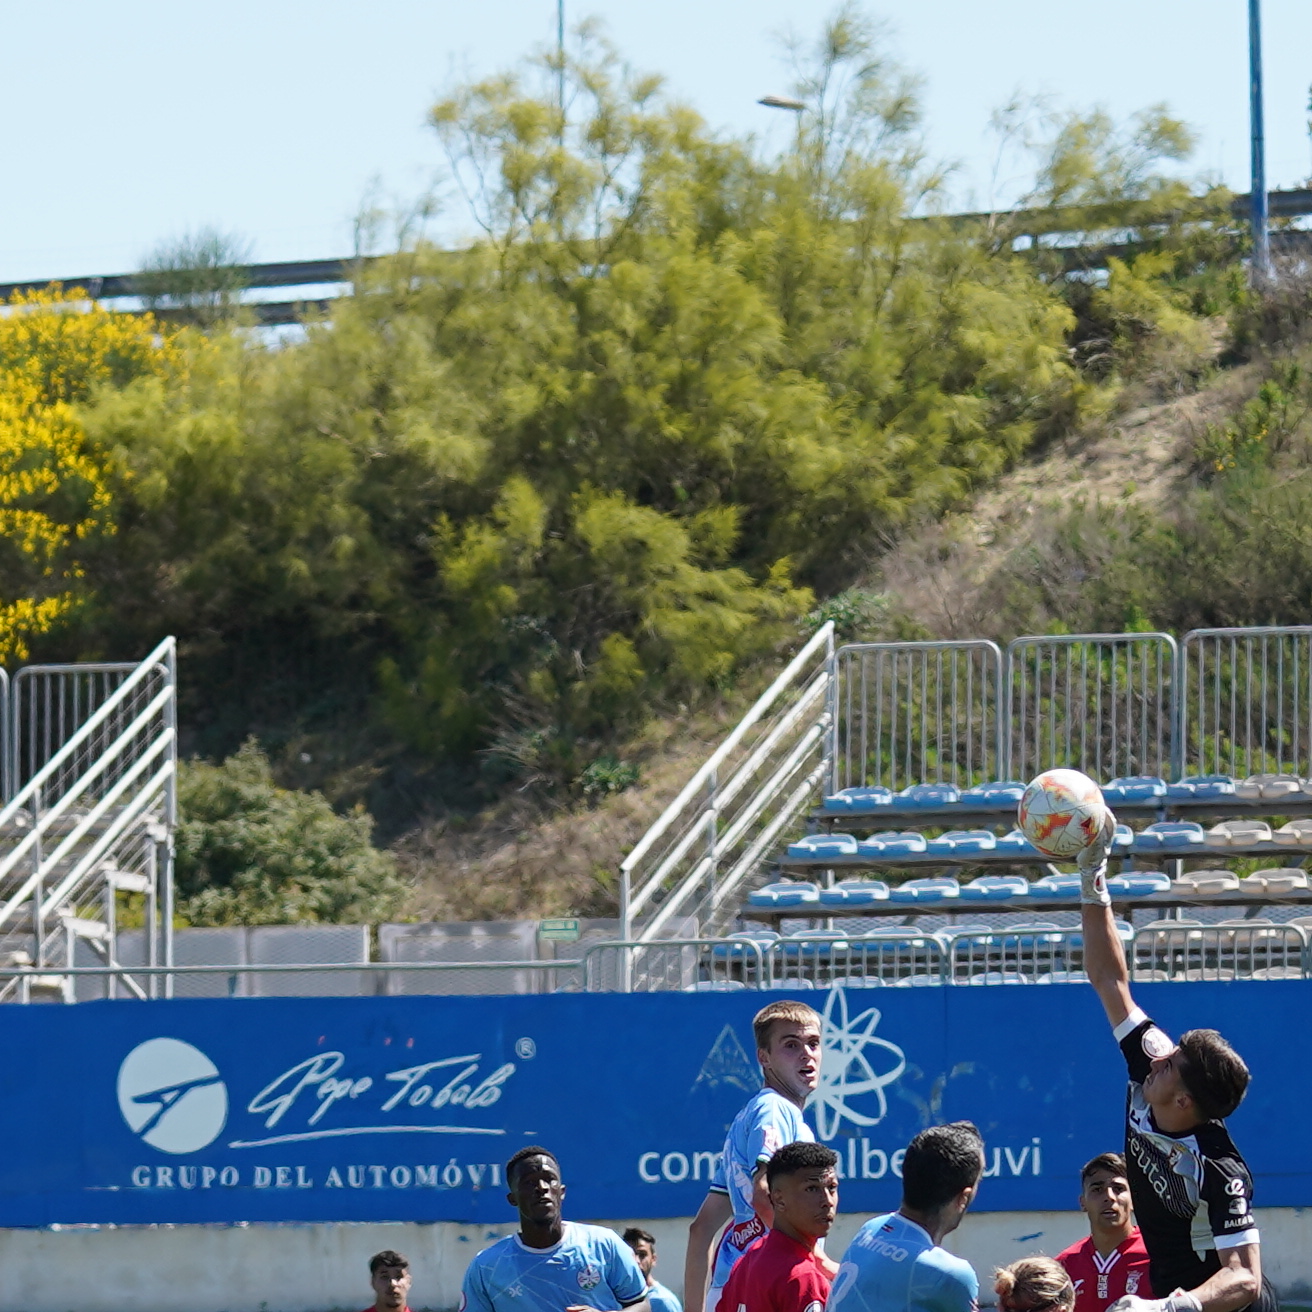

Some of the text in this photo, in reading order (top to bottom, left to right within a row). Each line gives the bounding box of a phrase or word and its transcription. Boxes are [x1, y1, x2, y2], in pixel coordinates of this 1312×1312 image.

[248, 1050, 373, 1129] Pepe
[132, 1158, 502, 1189] GRUPO DEL AUTOMÓVI
